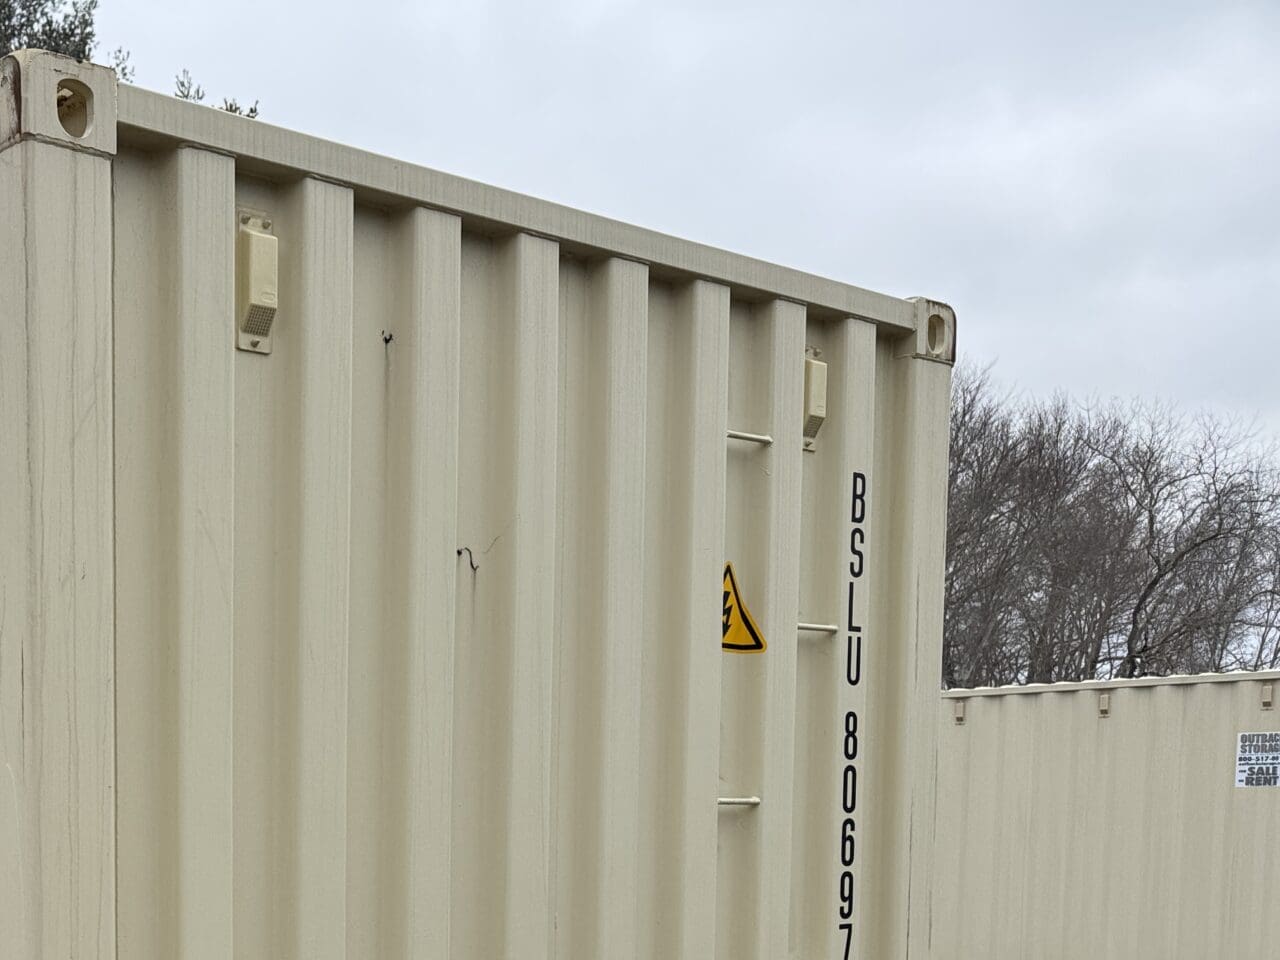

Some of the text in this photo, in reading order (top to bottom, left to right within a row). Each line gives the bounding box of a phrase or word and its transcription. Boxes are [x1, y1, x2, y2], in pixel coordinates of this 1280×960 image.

[846, 471, 866, 686] BSLU
[1247, 766, 1278, 776] SALE
[1245, 776, 1279, 786] RENT
